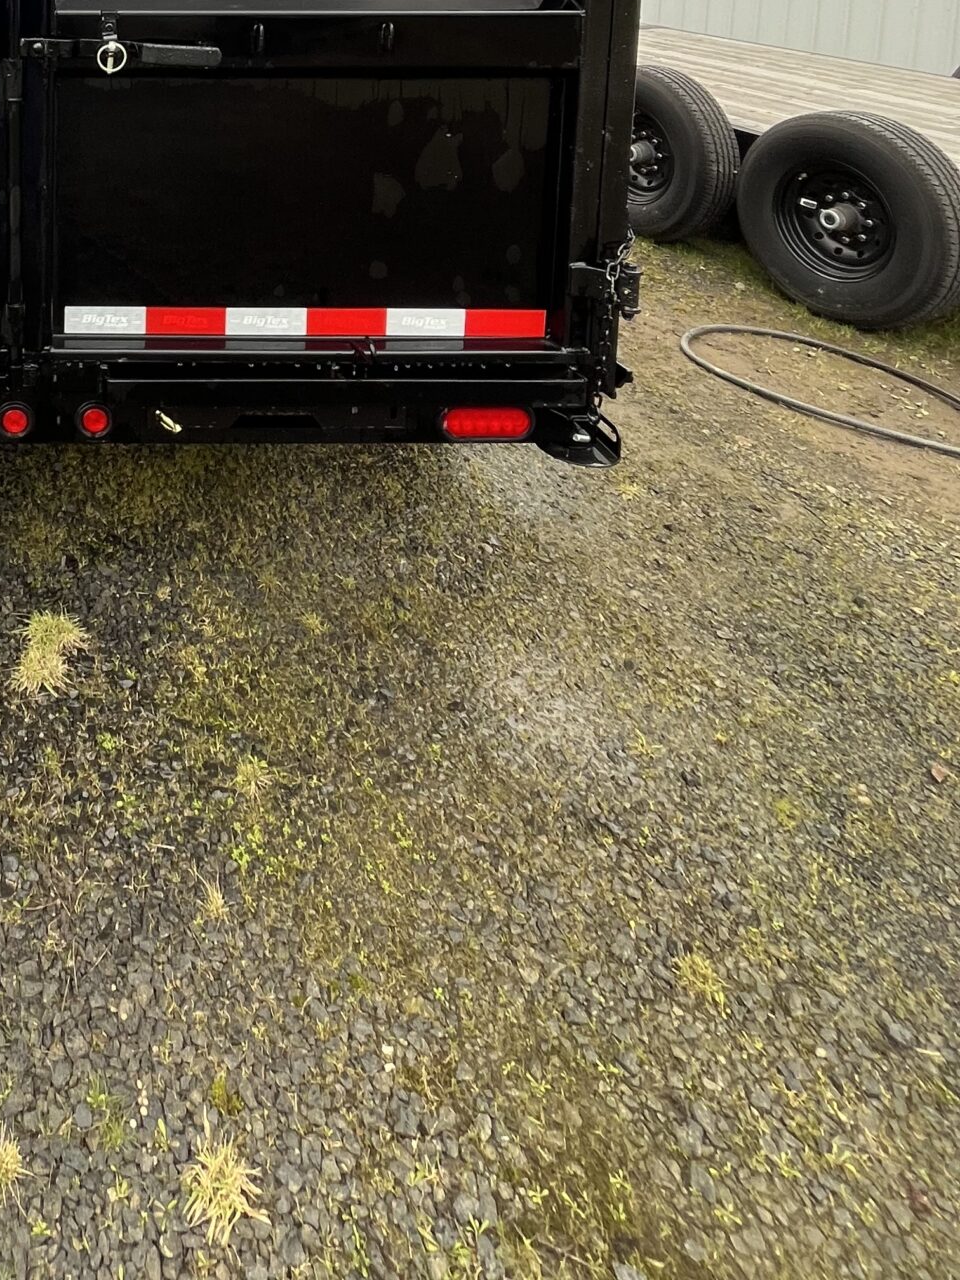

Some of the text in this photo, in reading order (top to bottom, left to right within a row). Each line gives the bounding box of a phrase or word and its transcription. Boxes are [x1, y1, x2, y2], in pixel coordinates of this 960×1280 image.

[81, 314, 128, 326] BigTex
[242, 315, 288, 327] BigTex
[401, 316, 448, 328] BigTex
